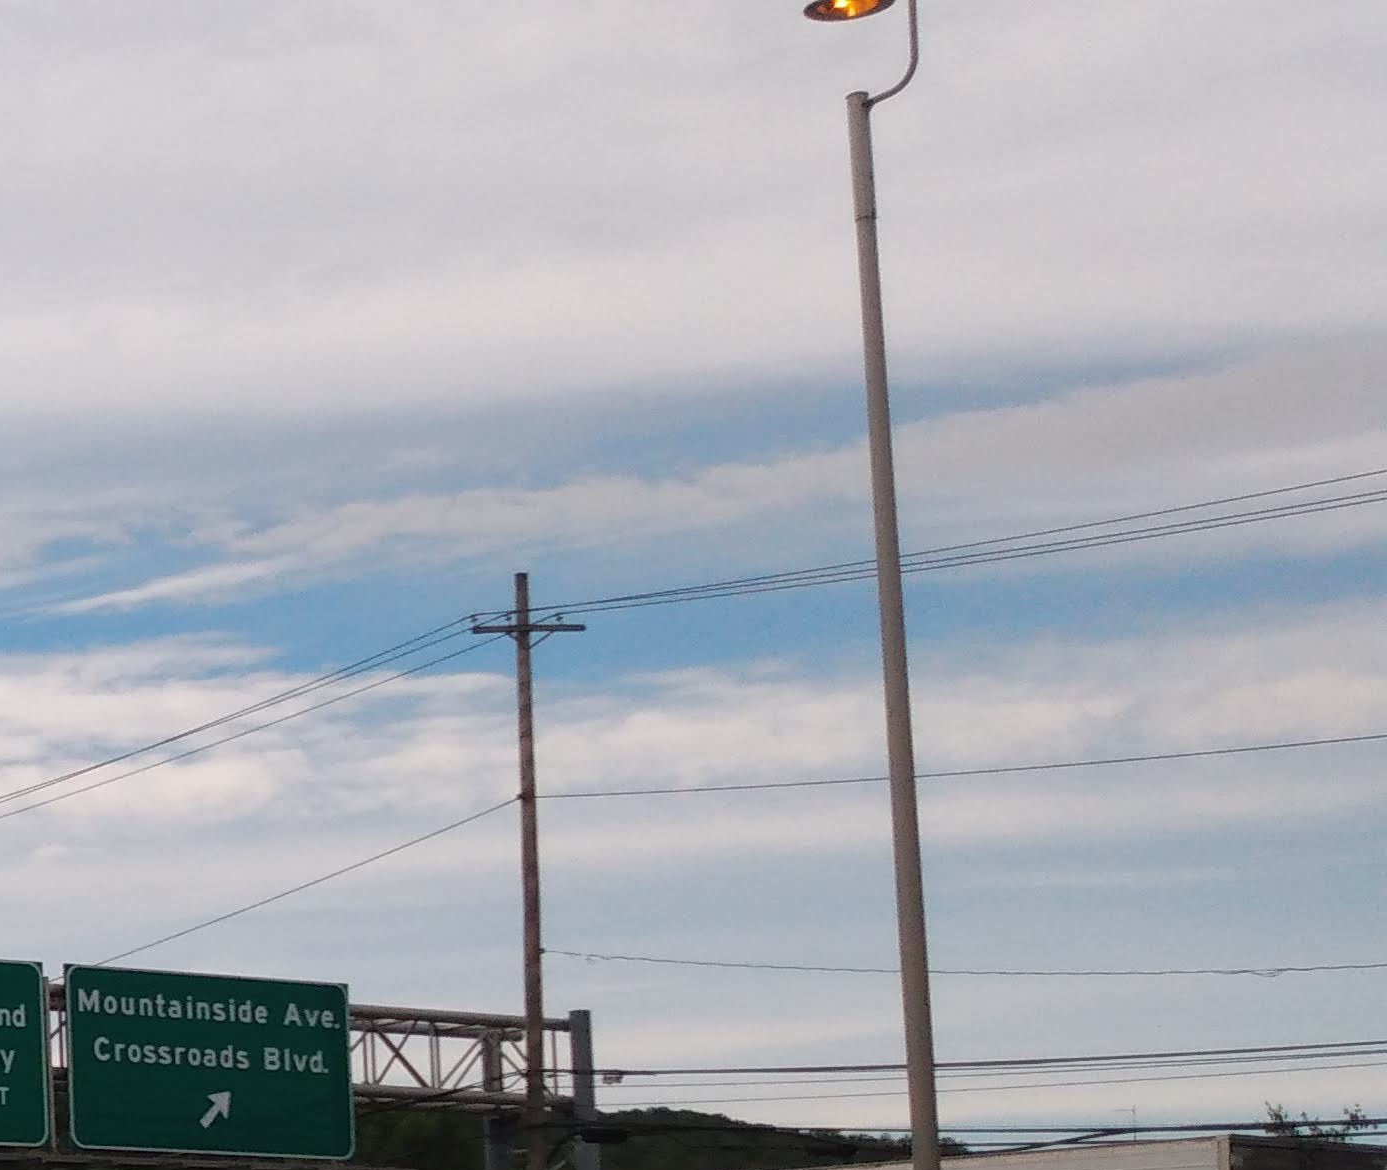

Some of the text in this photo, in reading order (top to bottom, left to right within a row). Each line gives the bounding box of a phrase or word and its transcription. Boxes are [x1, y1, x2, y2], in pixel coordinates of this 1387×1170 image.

[77, 988, 341, 1029] Mountainside Ave.
[93, 1036, 330, 1074] Crossroads Blvd.
